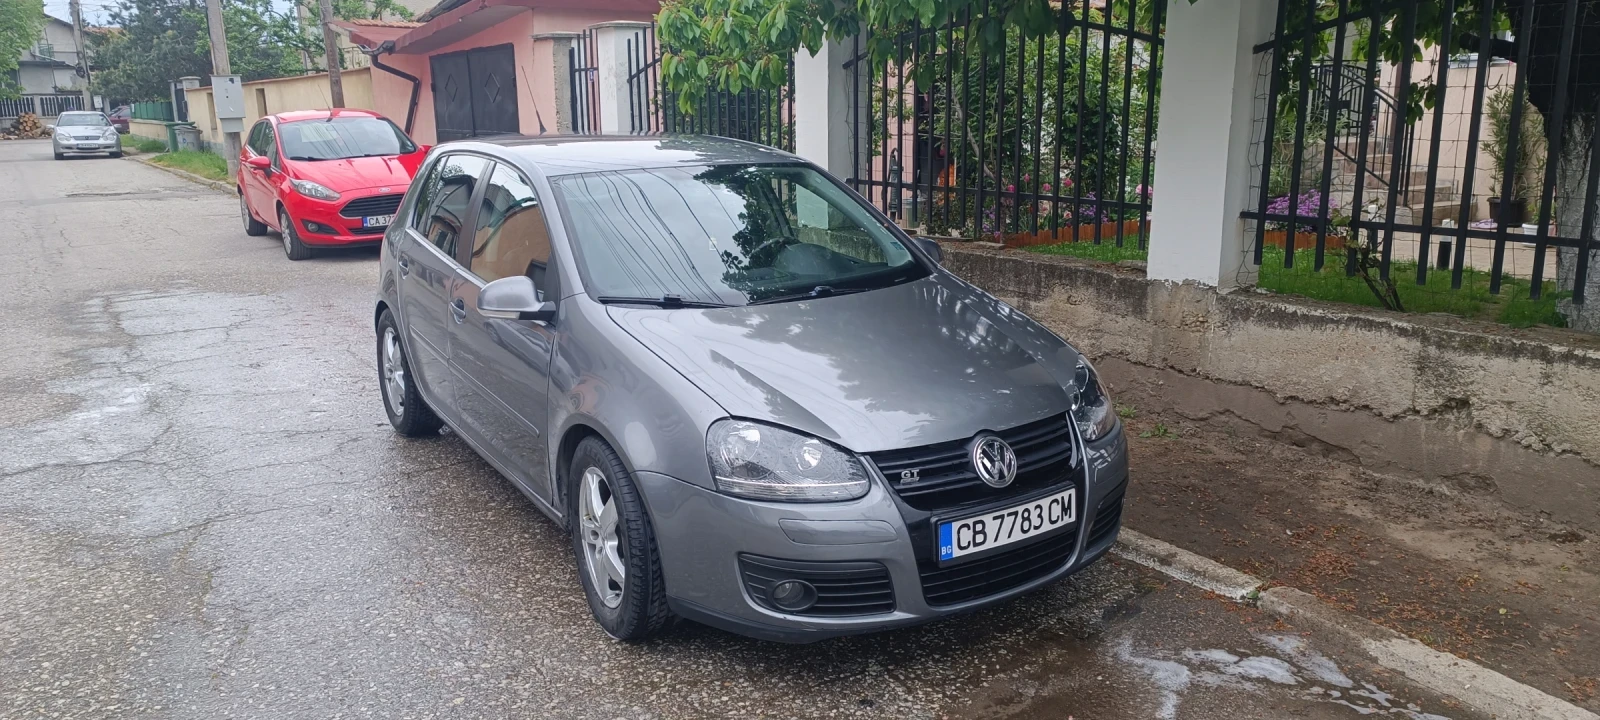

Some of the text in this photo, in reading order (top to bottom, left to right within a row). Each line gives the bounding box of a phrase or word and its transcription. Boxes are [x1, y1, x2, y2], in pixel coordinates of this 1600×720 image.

[368, 215, 394, 226] CA 37
[901, 469, 919, 479] GT
[956, 493, 1072, 551] CB 7783 CM
[941, 545, 952, 555] BG
